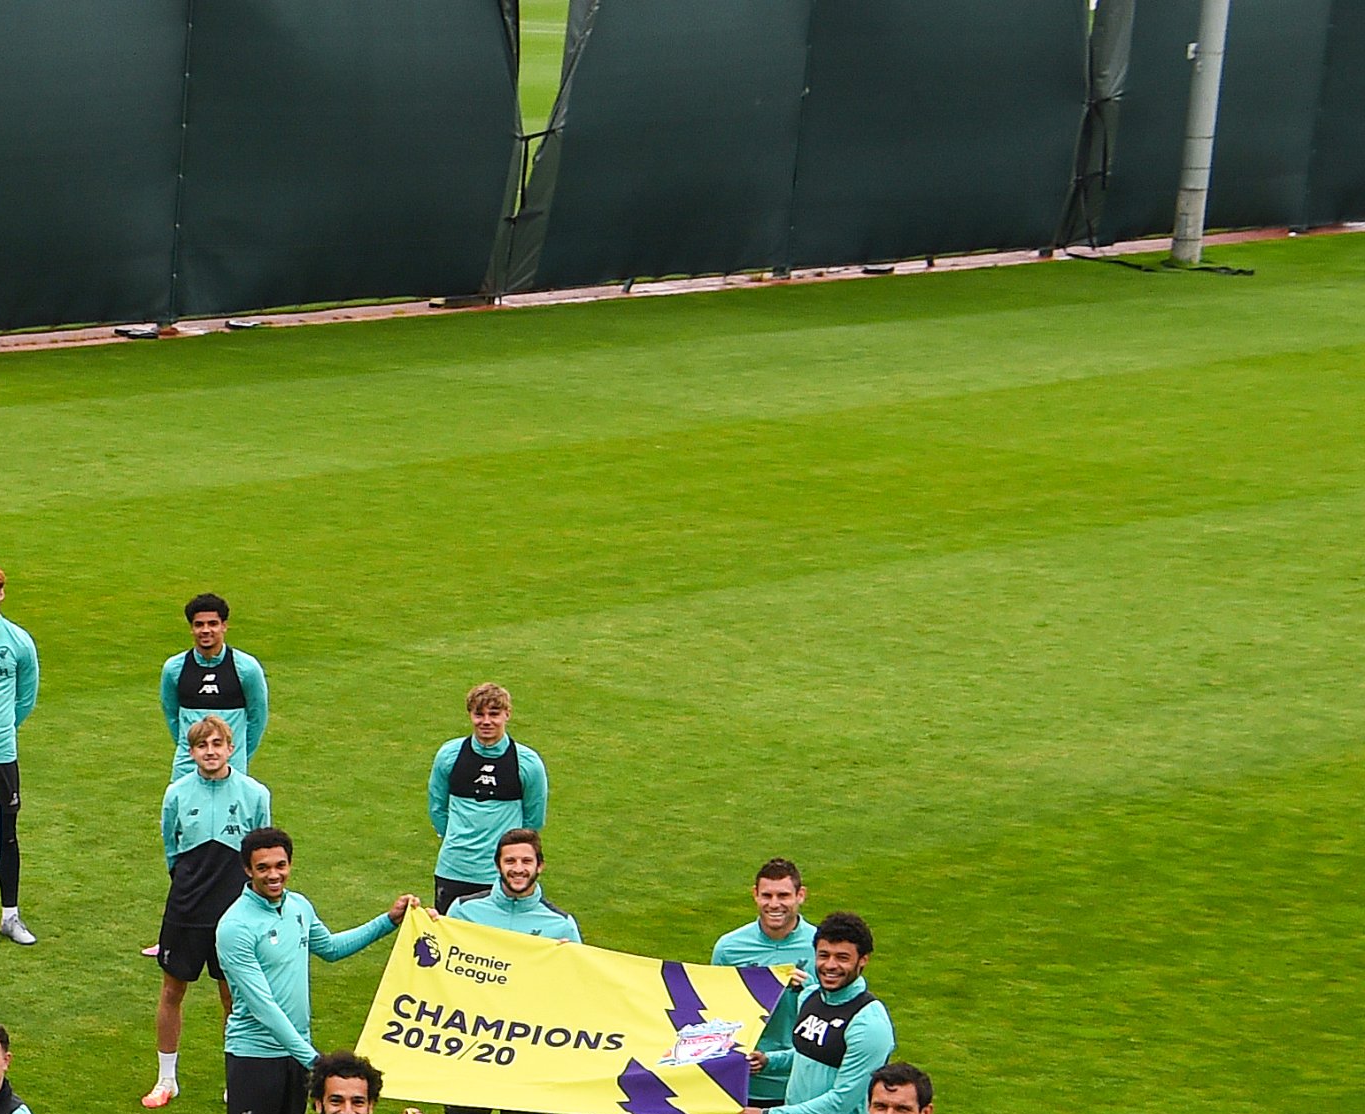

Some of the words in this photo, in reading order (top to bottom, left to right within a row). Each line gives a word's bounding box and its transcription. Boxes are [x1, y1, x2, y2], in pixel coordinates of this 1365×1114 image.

[198, 684, 219, 694] AXA
[473, 775, 497, 786] AXA
[220, 824, 242, 835] AXA
[448, 946, 511, 971] Premier
[446, 959, 507, 984] League
[394, 994, 624, 1050] CHAMPIONS
[793, 1014, 829, 1046] AXA
[382, 1021, 515, 1065] 2019/20
